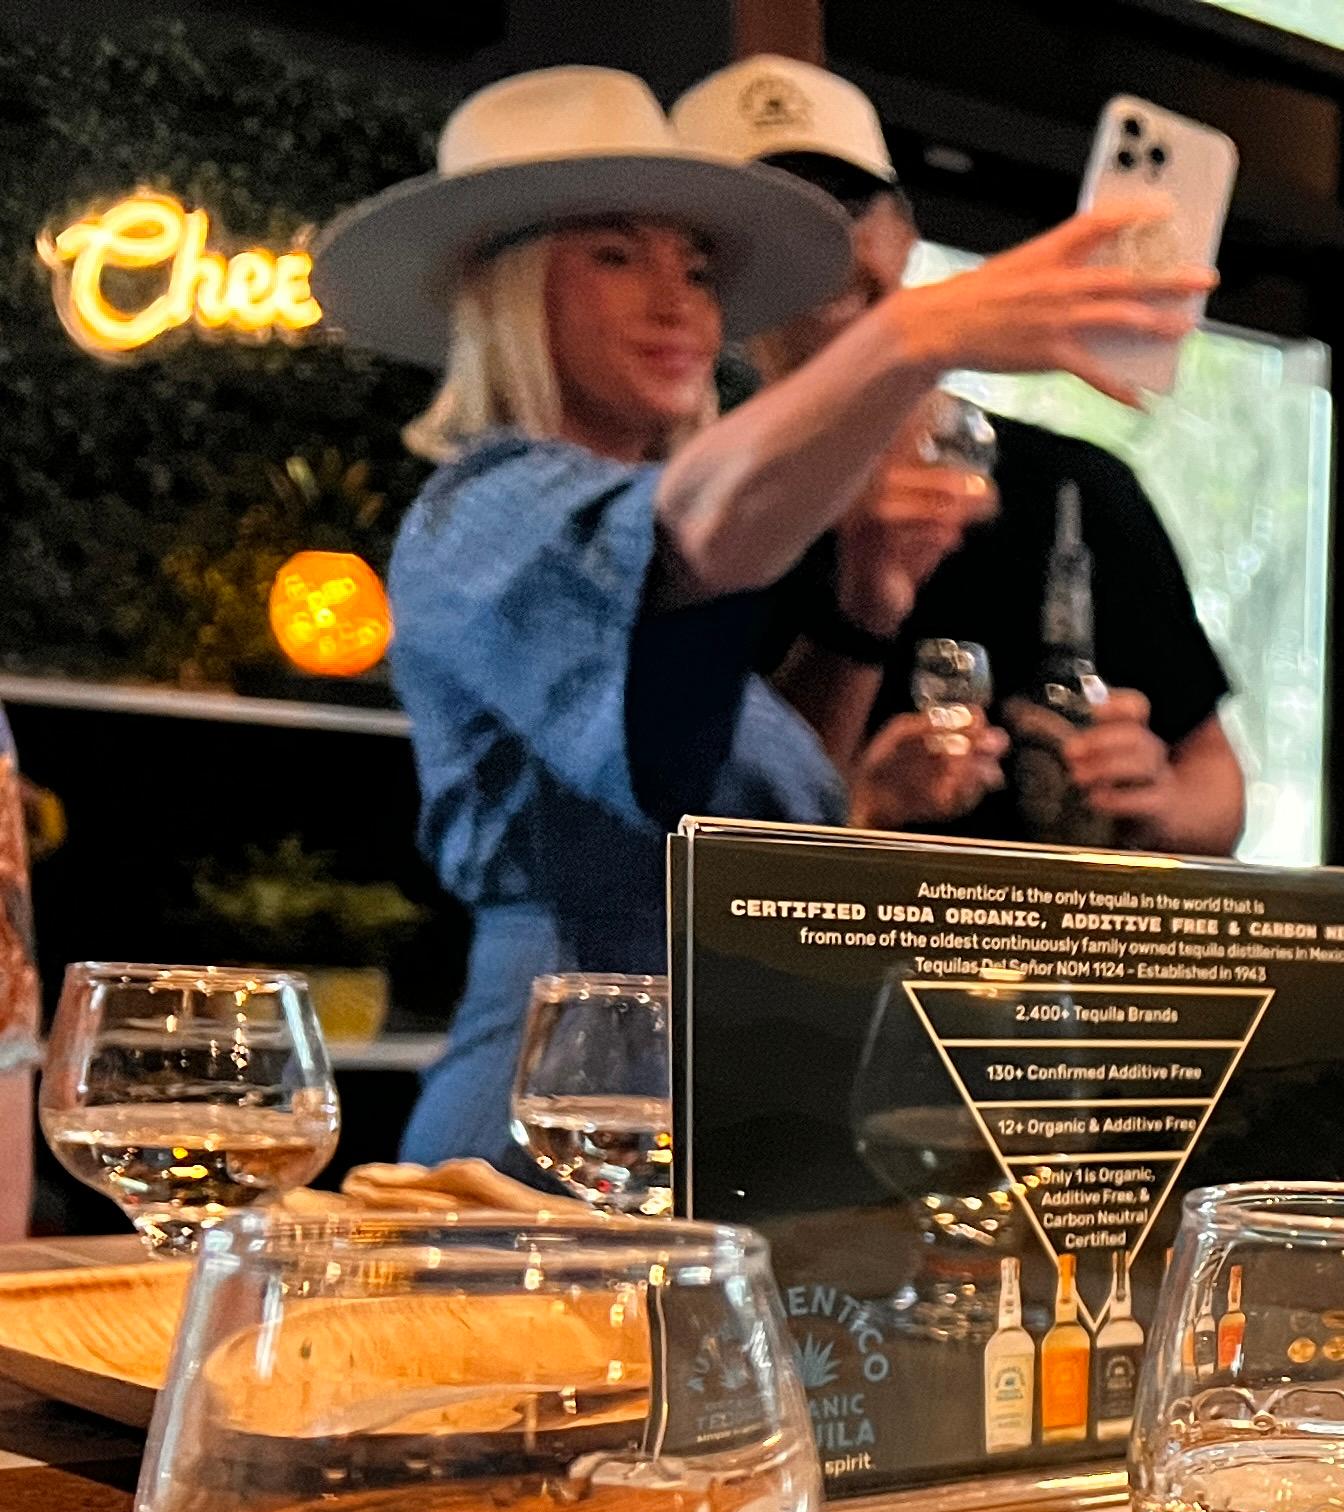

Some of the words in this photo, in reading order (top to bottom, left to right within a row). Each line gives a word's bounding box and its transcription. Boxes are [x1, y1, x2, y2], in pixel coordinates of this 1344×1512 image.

[1011, 885, 1025, 903] is
[1026, 887, 1053, 904] the
[1055, 890, 1088, 909] only
[1089, 890, 1139, 911] tequila
[1140, 892, 1154, 909] in
[1157, 894, 1180, 911] the
[1182, 896, 1220, 912] world
[1222, 897, 1252, 914] that
[1253, 899, 1265, 915] is
[730, 898, 867, 921] CERTIFIED
[877, 905, 935, 924] USDA
[945, 906, 1048, 929] ORGANIC,
[1061, 912, 1162, 933] ADDITIVE
[1171, 917, 1220, 935] FREE
[1228, 920, 1241, 936] &
[1249, 921, 1318, 940] CARBON
[800, 926, 843, 945] from
[845, 930, 876, 947] one
[878, 929, 898, 947] of
[900, 930, 927, 948] the
[930, 932, 979, 950] oldest
[982, 934, 1080, 957] continuously
[1081, 937, 1128, 957] family
[1129, 940, 1177, 957] owned
[1179, 942, 1226, 961] tequila
[1226, 943, 1294, 961] distilleries
[1296, 946, 1308, 960] in
[915, 956, 979, 977] Tequilas
[1009, 957, 1054, 976] Señor
[1055, 961, 1092, 976] NOM
[1093, 962, 1125, 979] 1124
[1137, 963, 1217, 981] Established
[1218, 965, 1232, 981] in
[1015, 1004, 1070, 1023] 2,400+
[1073, 1005, 1125, 1024] Tequila
[1127, 1006, 1179, 1023] Brands
[986, 1064, 1025, 1081] 130+
[1027, 1063, 1106, 1081] Confirmed
[1108, 1064, 1169, 1081] Additive
[1170, 1063, 1202, 1081] Free
[998, 1119, 1025, 1136] 12+
[1027, 1117, 1086, 1138] Organic
[1088, 1117, 1100, 1133] &
[1102, 1115, 1163, 1133] Additive
[1164, 1115, 1197, 1132] Free
[1074, 1168, 1083, 1183] 1
[1084, 1167, 1097, 1184] is
[1099, 1166, 1156, 1187] Organic,
[1041, 1189, 1101, 1206] Additive
[1102, 1187, 1137, 1204] Free,
[1139, 1186, 1150, 1202] &
[1043, 1212, 1095, 1229] Carbon
[1097, 1208, 1149, 1226] Neutral
[1065, 1229, 1127, 1249] Certified
[824, 1451, 873, 1478] spirit
